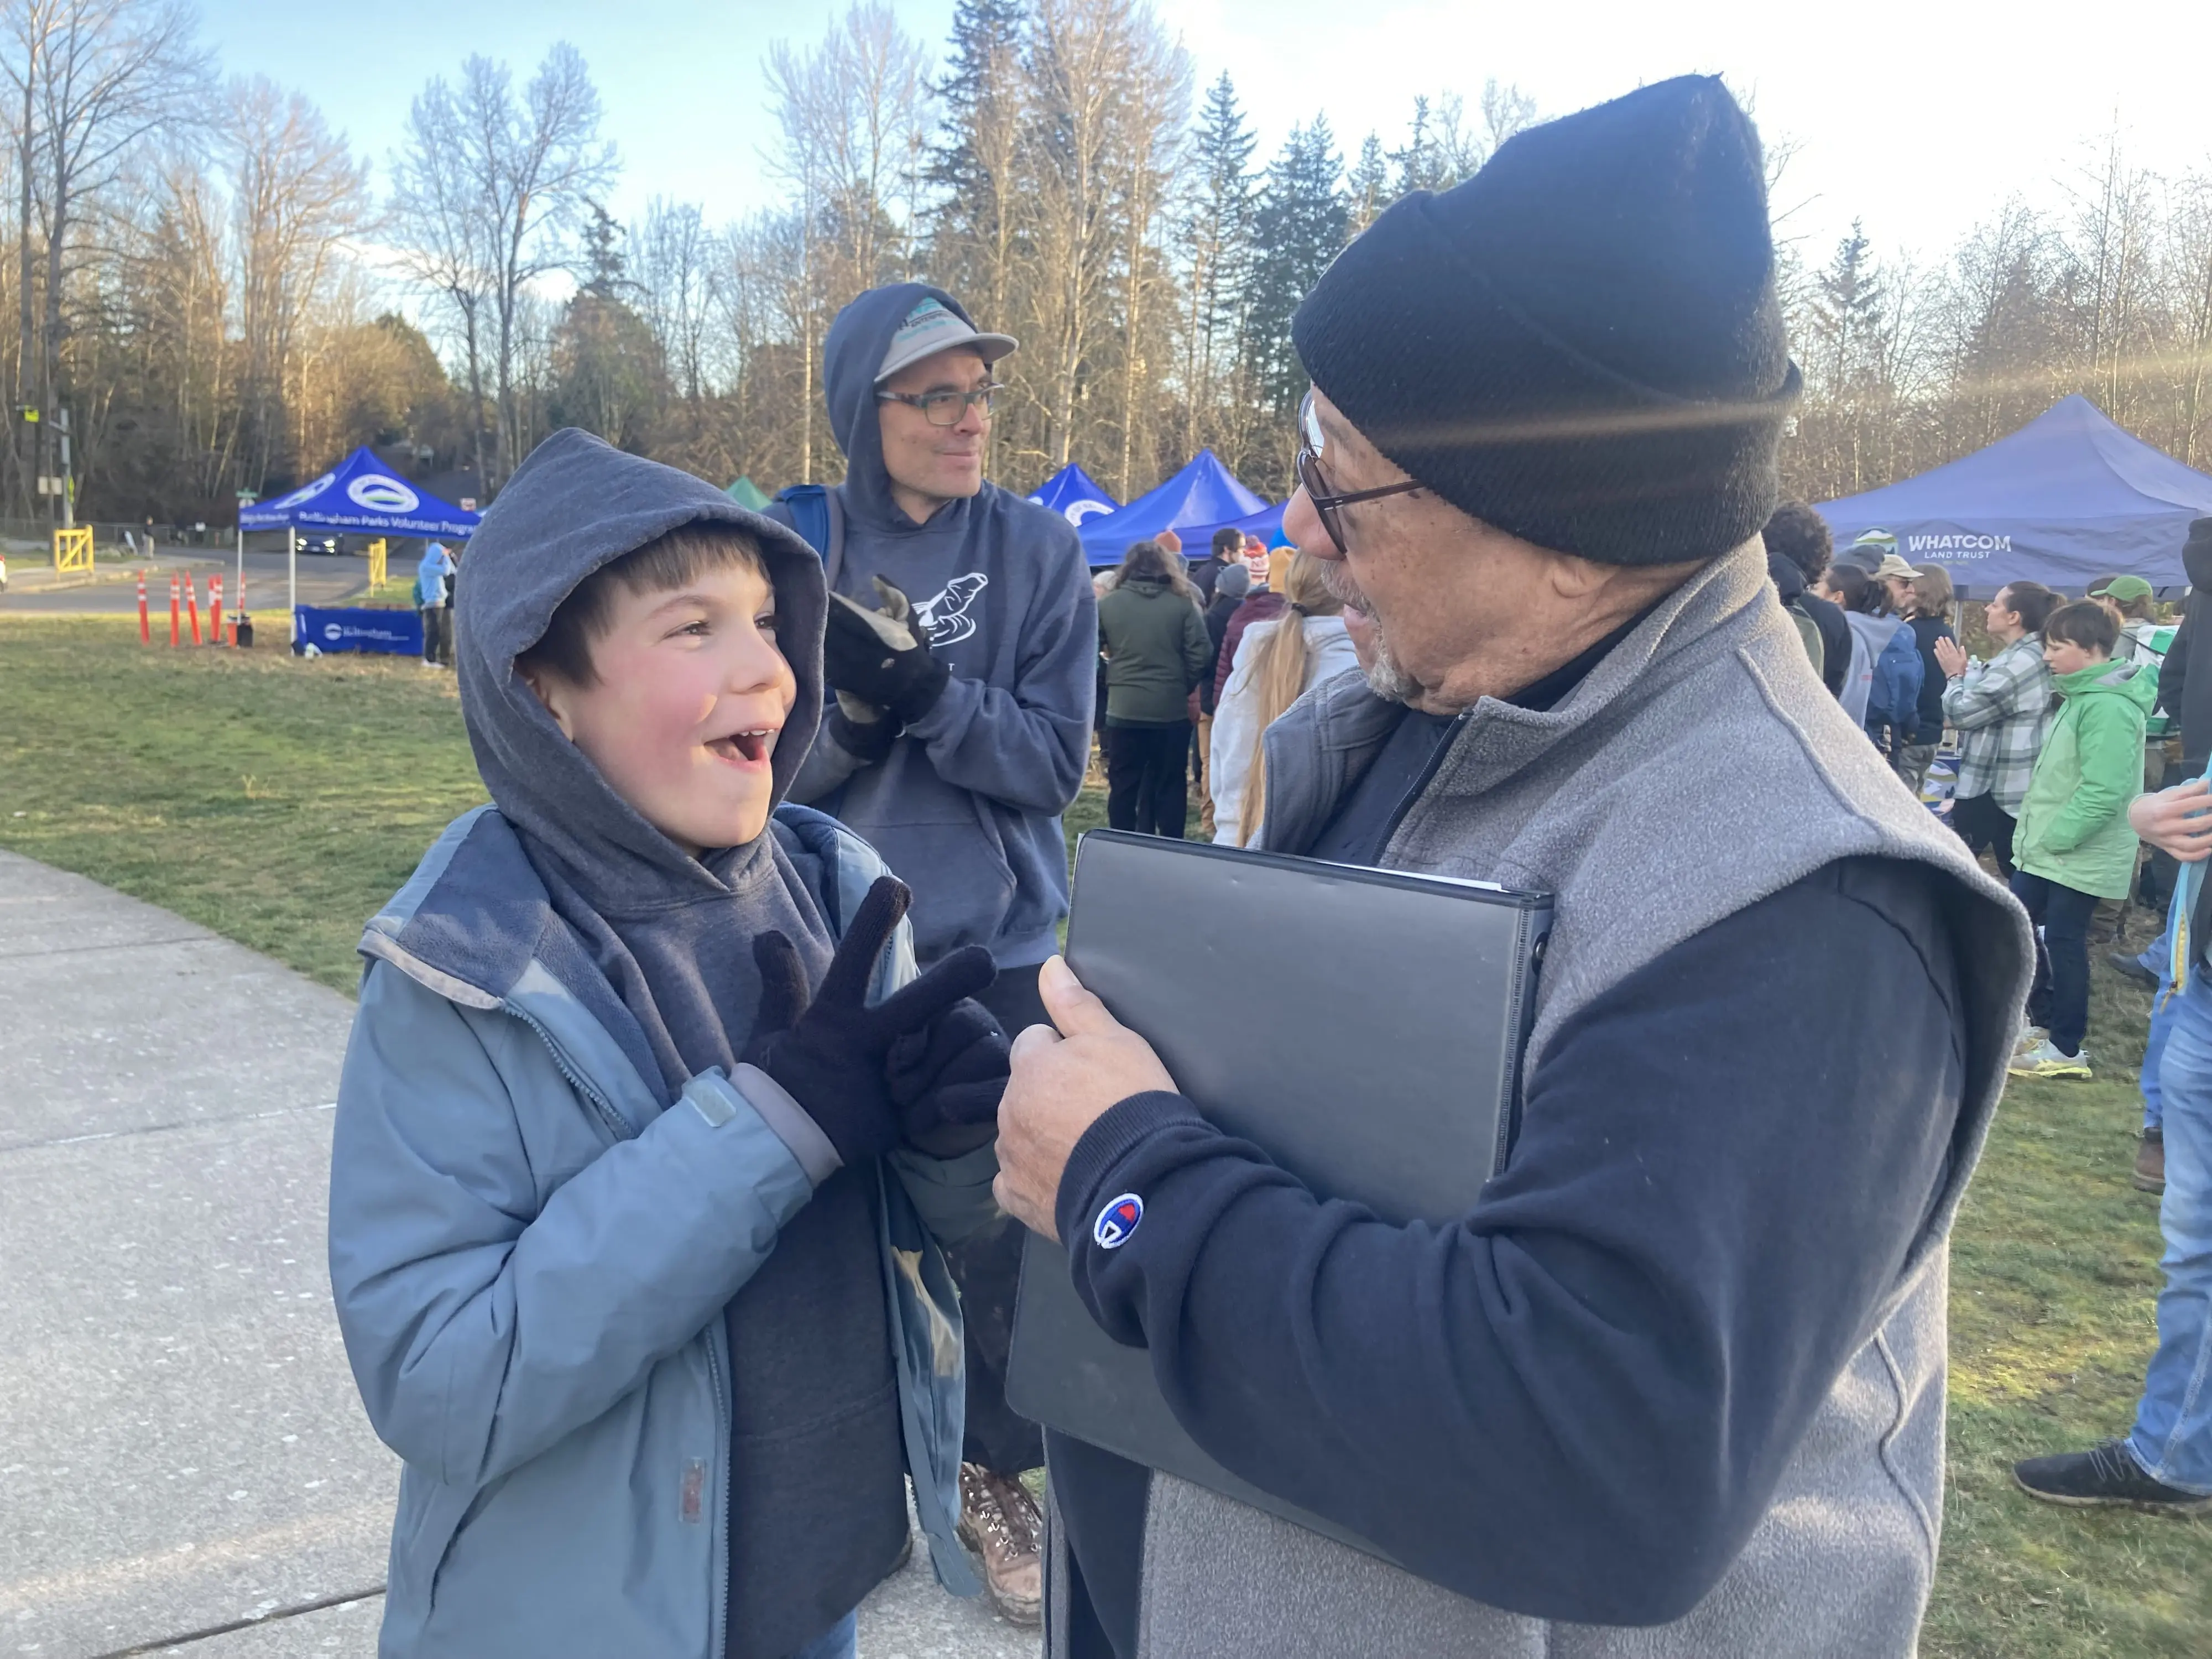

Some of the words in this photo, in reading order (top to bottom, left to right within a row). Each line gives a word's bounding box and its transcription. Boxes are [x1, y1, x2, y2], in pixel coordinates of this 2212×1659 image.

[299, 510, 360, 526] Bellingham
[362, 515, 389, 528] Parks
[390, 516, 440, 531] Volunteer
[1908, 535, 2011, 552] WHATCOM
